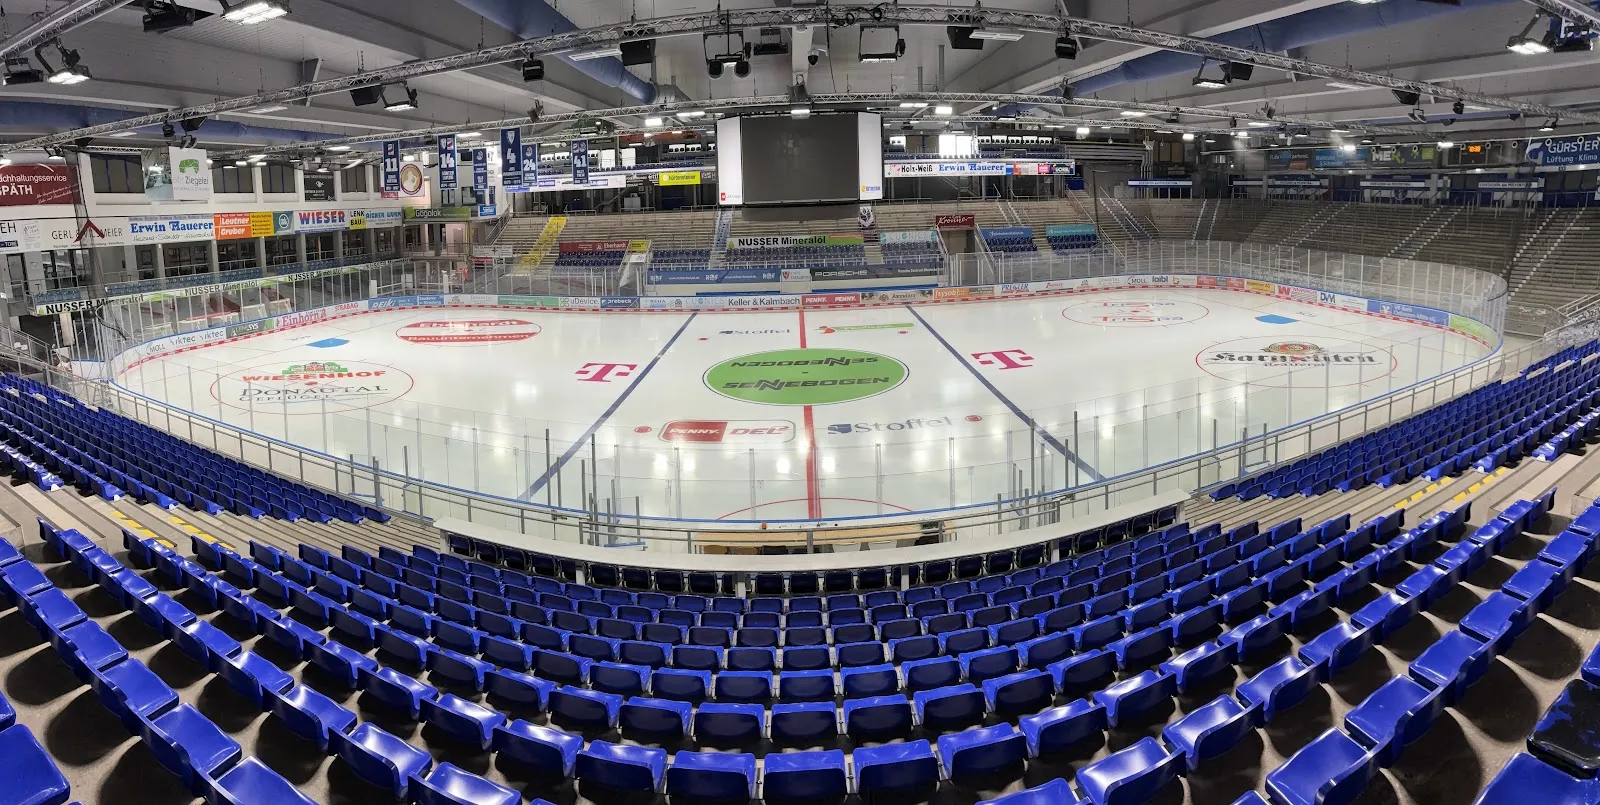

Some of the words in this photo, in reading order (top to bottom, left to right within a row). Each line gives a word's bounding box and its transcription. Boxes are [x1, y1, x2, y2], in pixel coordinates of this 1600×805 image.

[440, 153, 454, 168] 14
[506, 148, 516, 164] 4
[574, 155, 586, 167] 41
[385, 158, 398, 172] 11
[524, 159, 536, 171] 24
[185, 176, 209, 186] Ziegelei
[299, 211, 345, 225] WIESER
[131, 222, 166, 233] Erwin
[738, 238, 778, 246] NUSSER
[781, 236, 826, 245] Mineralöl
[185, 285, 219, 296] NUSSER
[335, 302, 358, 312] STRABAG
[760, 297, 800, 305] Kalmbach
[46, 301, 93, 314] NUSSER
[282, 310, 319, 326] Einhorn
[242, 371, 386, 382] WIESENHOF
[722, 376, 890, 391] SENNEBOGEN
[851, 416, 952, 434] Stoffel
